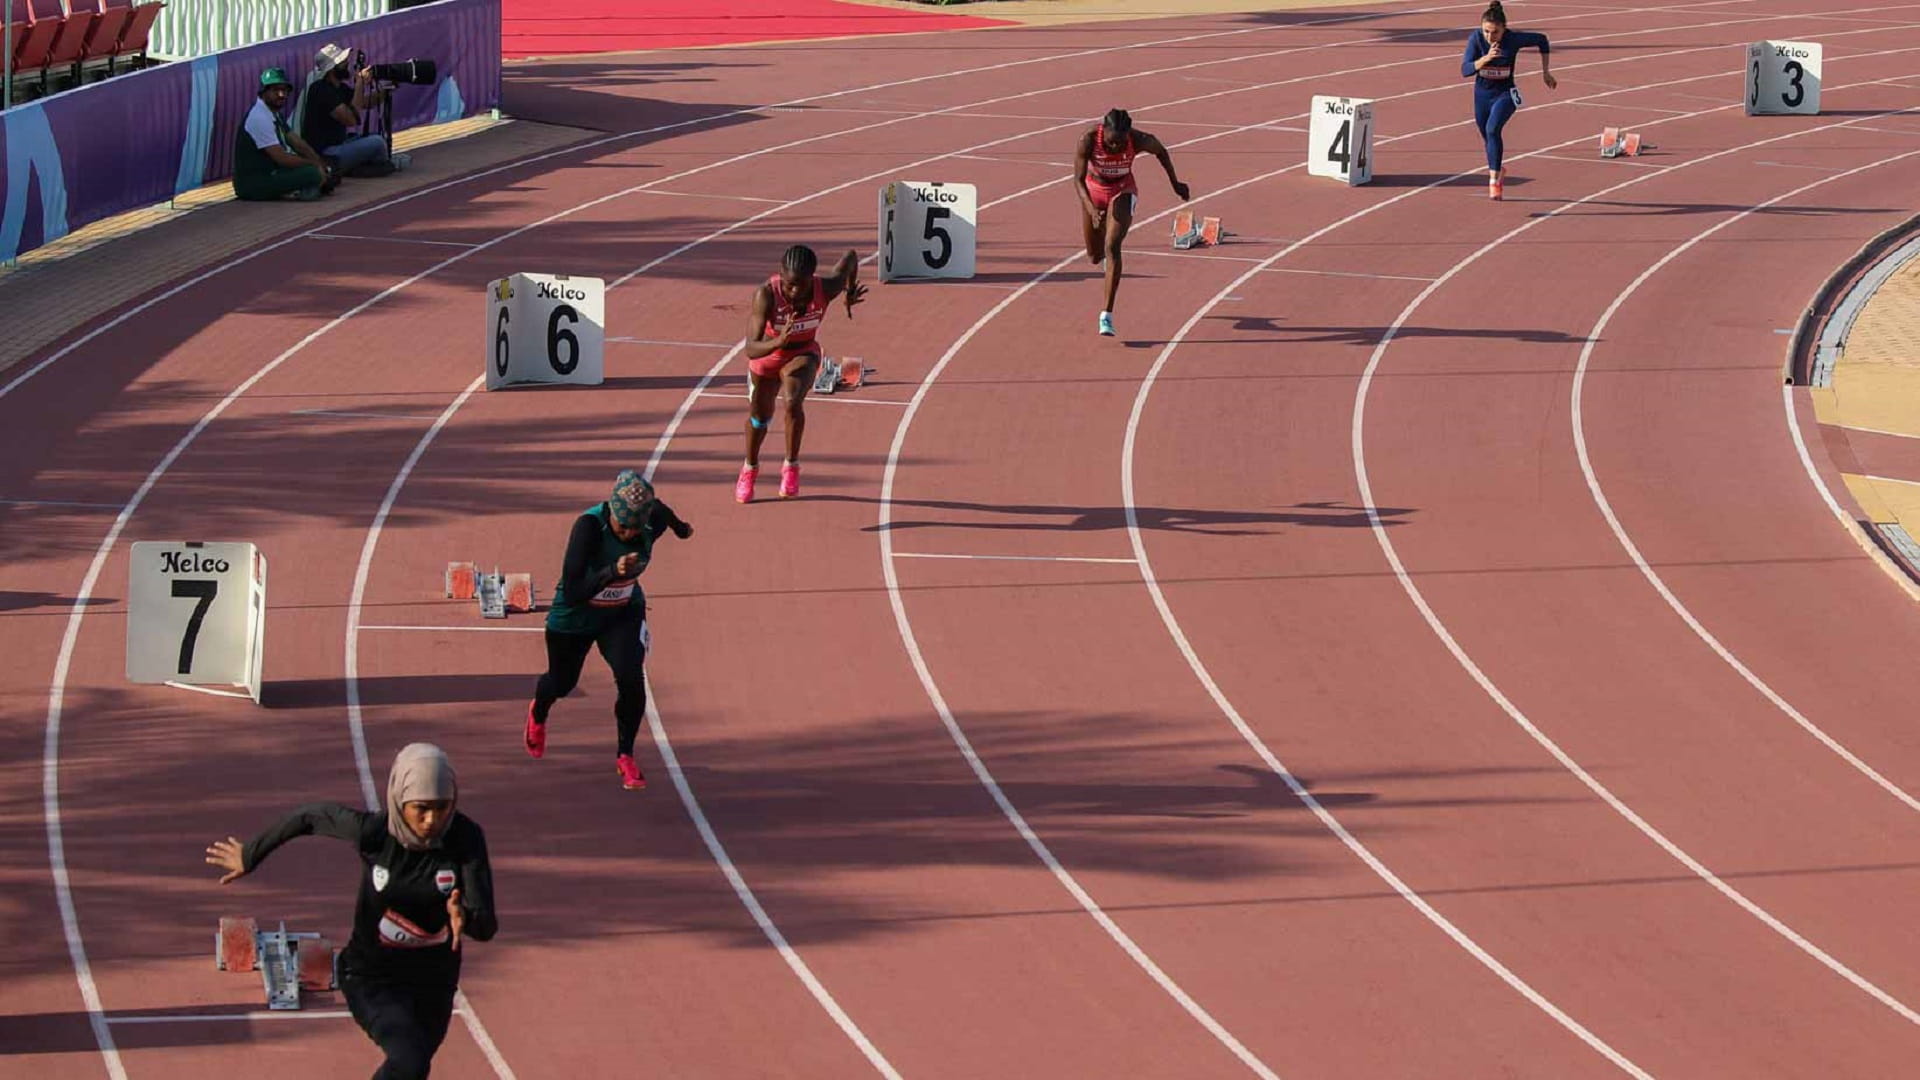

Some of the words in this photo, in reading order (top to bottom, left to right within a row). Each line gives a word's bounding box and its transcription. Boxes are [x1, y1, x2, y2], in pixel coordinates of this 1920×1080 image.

[1325, 102, 1353, 115] Nelc
[1751, 60, 1760, 107] 3
[1782, 61, 1804, 107] 3
[1328, 120, 1350, 173] 4
[1357, 124, 1367, 177] 4
[913, 187, 958, 203] Nelco
[885, 210, 894, 273] 5
[922, 207, 952, 269] 5
[537, 282, 586, 300] Nelco
[495, 306, 509, 378] 6
[547, 305, 580, 375] 6
[160, 551, 230, 573] Nelco
[171, 580, 218, 674] 7
